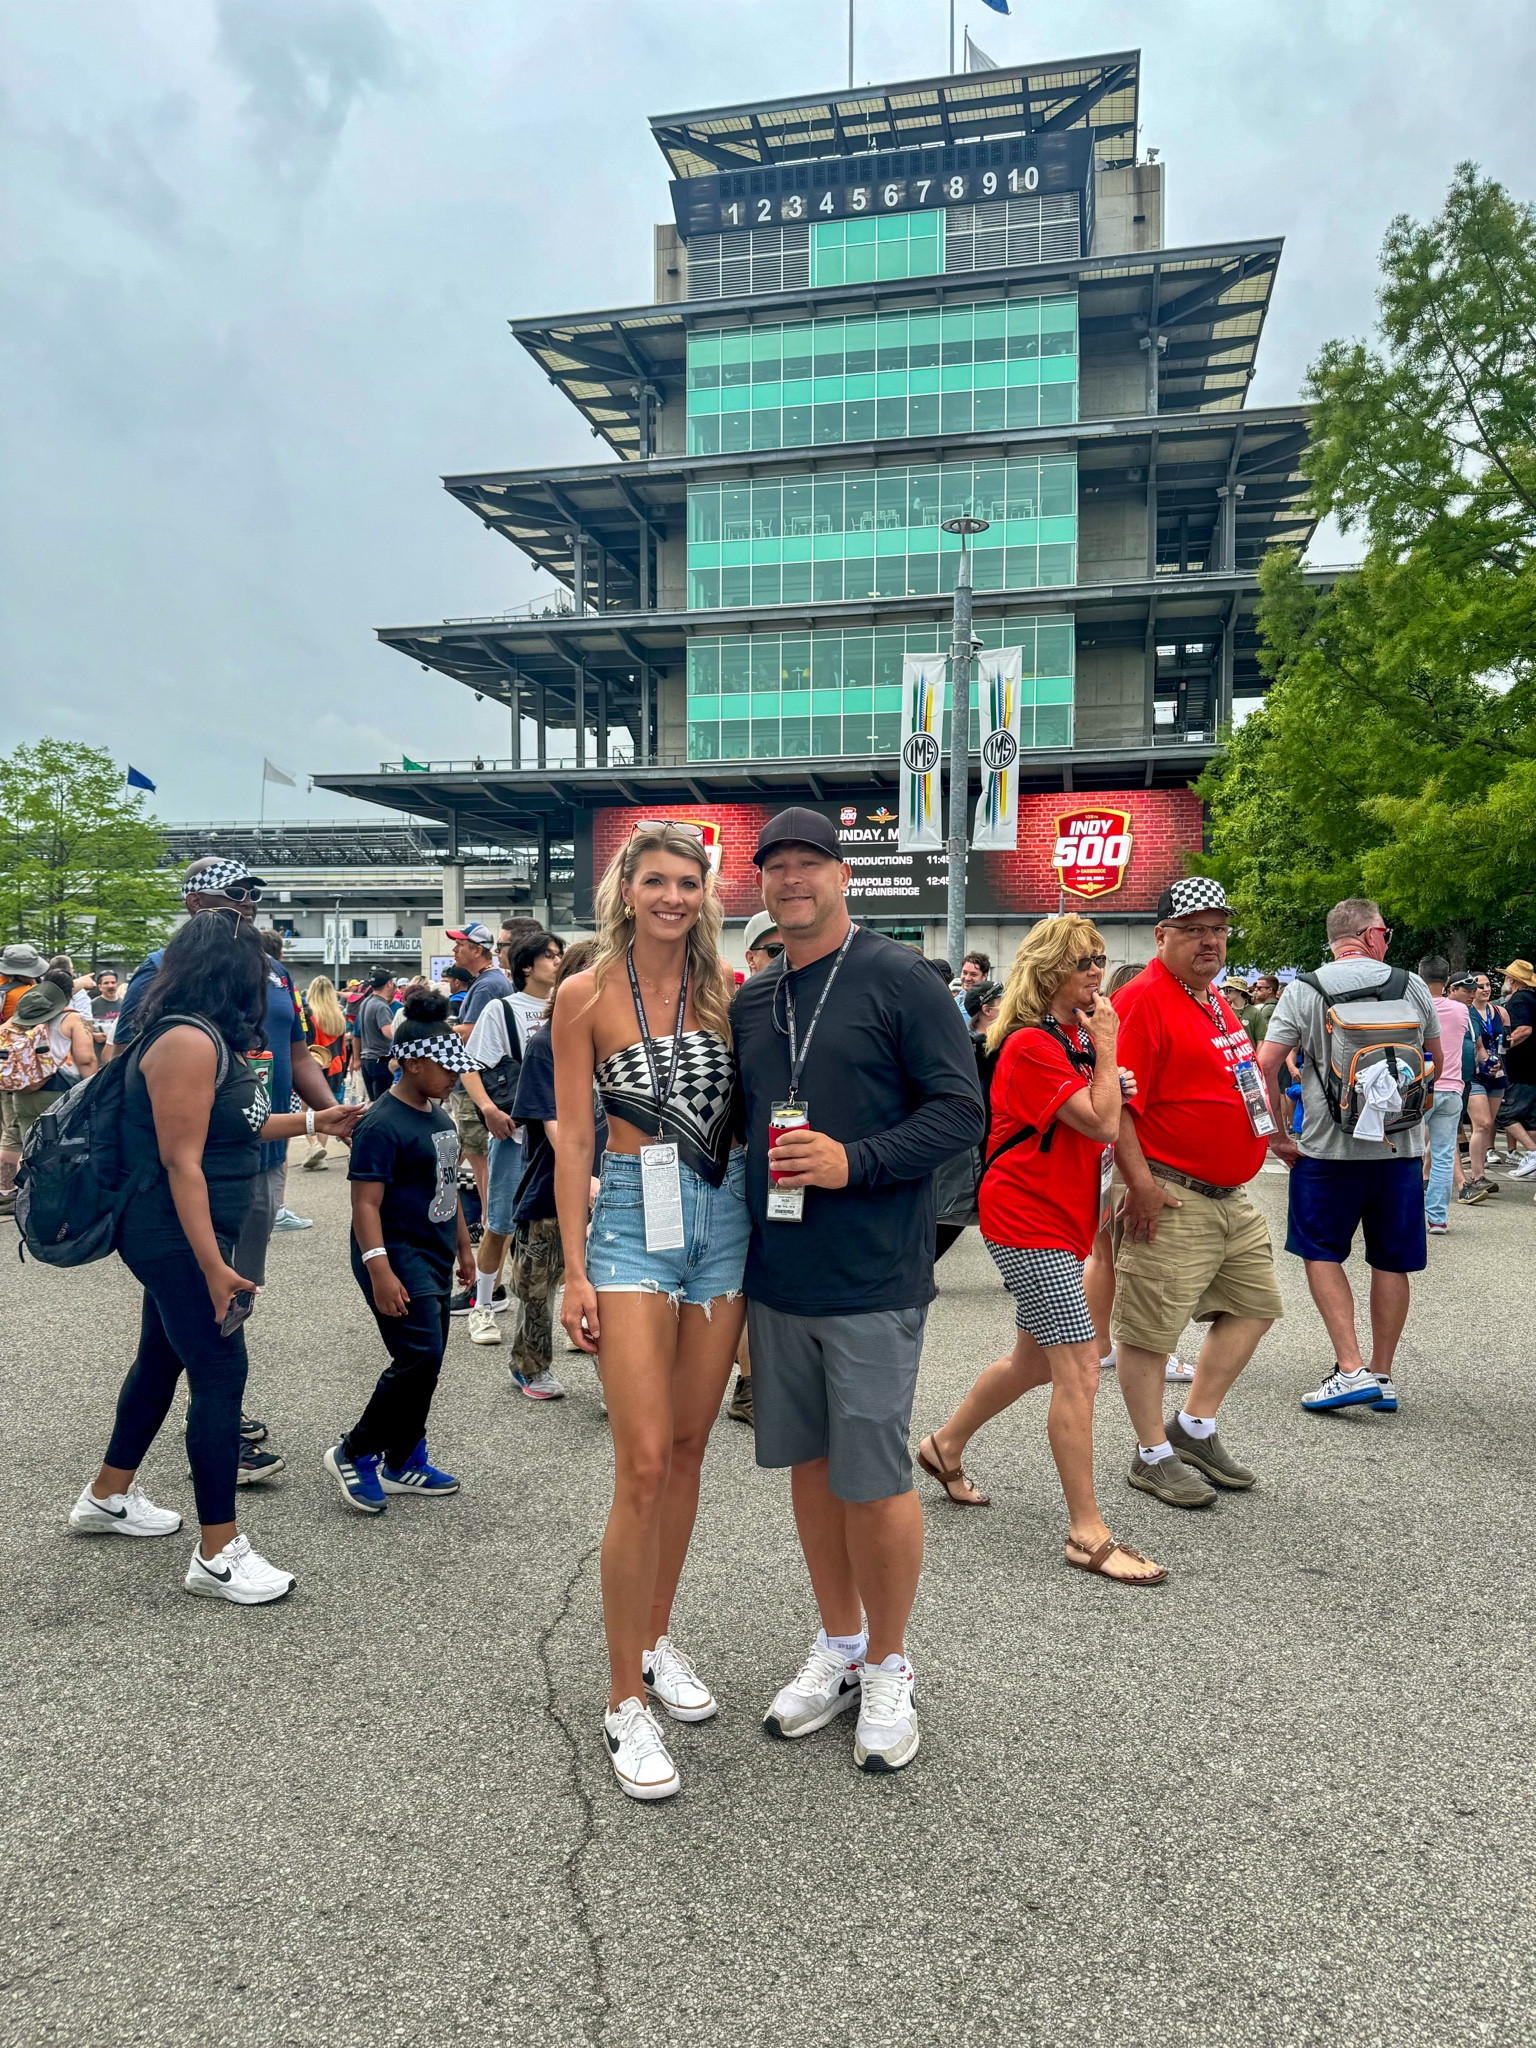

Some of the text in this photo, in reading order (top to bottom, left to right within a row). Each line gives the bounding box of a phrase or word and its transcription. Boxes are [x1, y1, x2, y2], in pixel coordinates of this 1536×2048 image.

[728, 166, 1039, 225] 1 2 3 4 5 6 7 8 9 10
[910, 739, 934, 767] IMS
[990, 735, 1011, 764] IMS
[836, 828, 884, 841] UNDAY,
[1069, 819, 1113, 836] INDY
[1053, 835, 1130, 867] 500
[843, 856, 913, 866] TRODUCTIONS
[847, 877, 892, 887] ANAPOLIS
[893, 877, 912, 886] 500
[851, 888, 864, 896] BY
[865, 887, 920, 896] GAINBRIDGE
[369, 939, 422, 950] THE RACING CA
